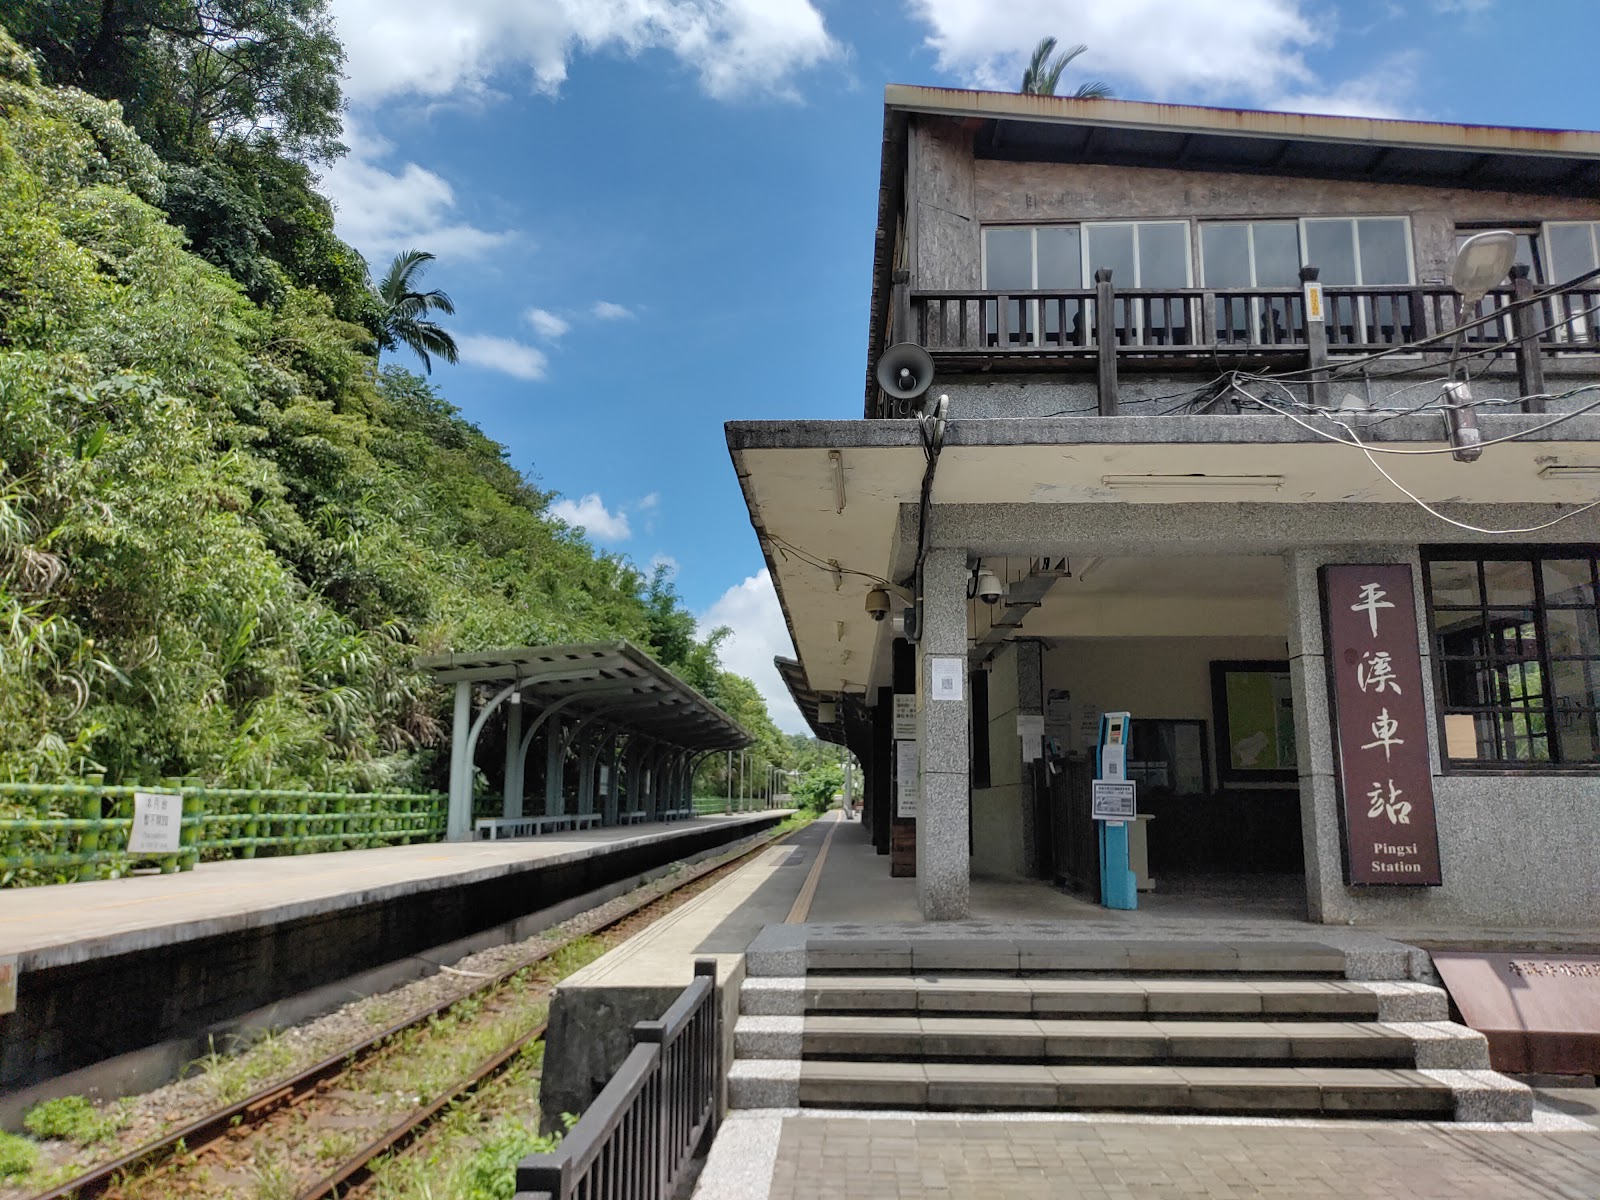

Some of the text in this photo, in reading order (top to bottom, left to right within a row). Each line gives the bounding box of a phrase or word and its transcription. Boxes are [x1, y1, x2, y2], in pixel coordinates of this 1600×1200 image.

[1350, 582, 1412, 825] 平溪車站
[1373, 842, 1417, 856] Pingxi
[1371, 860, 1421, 873] Station
